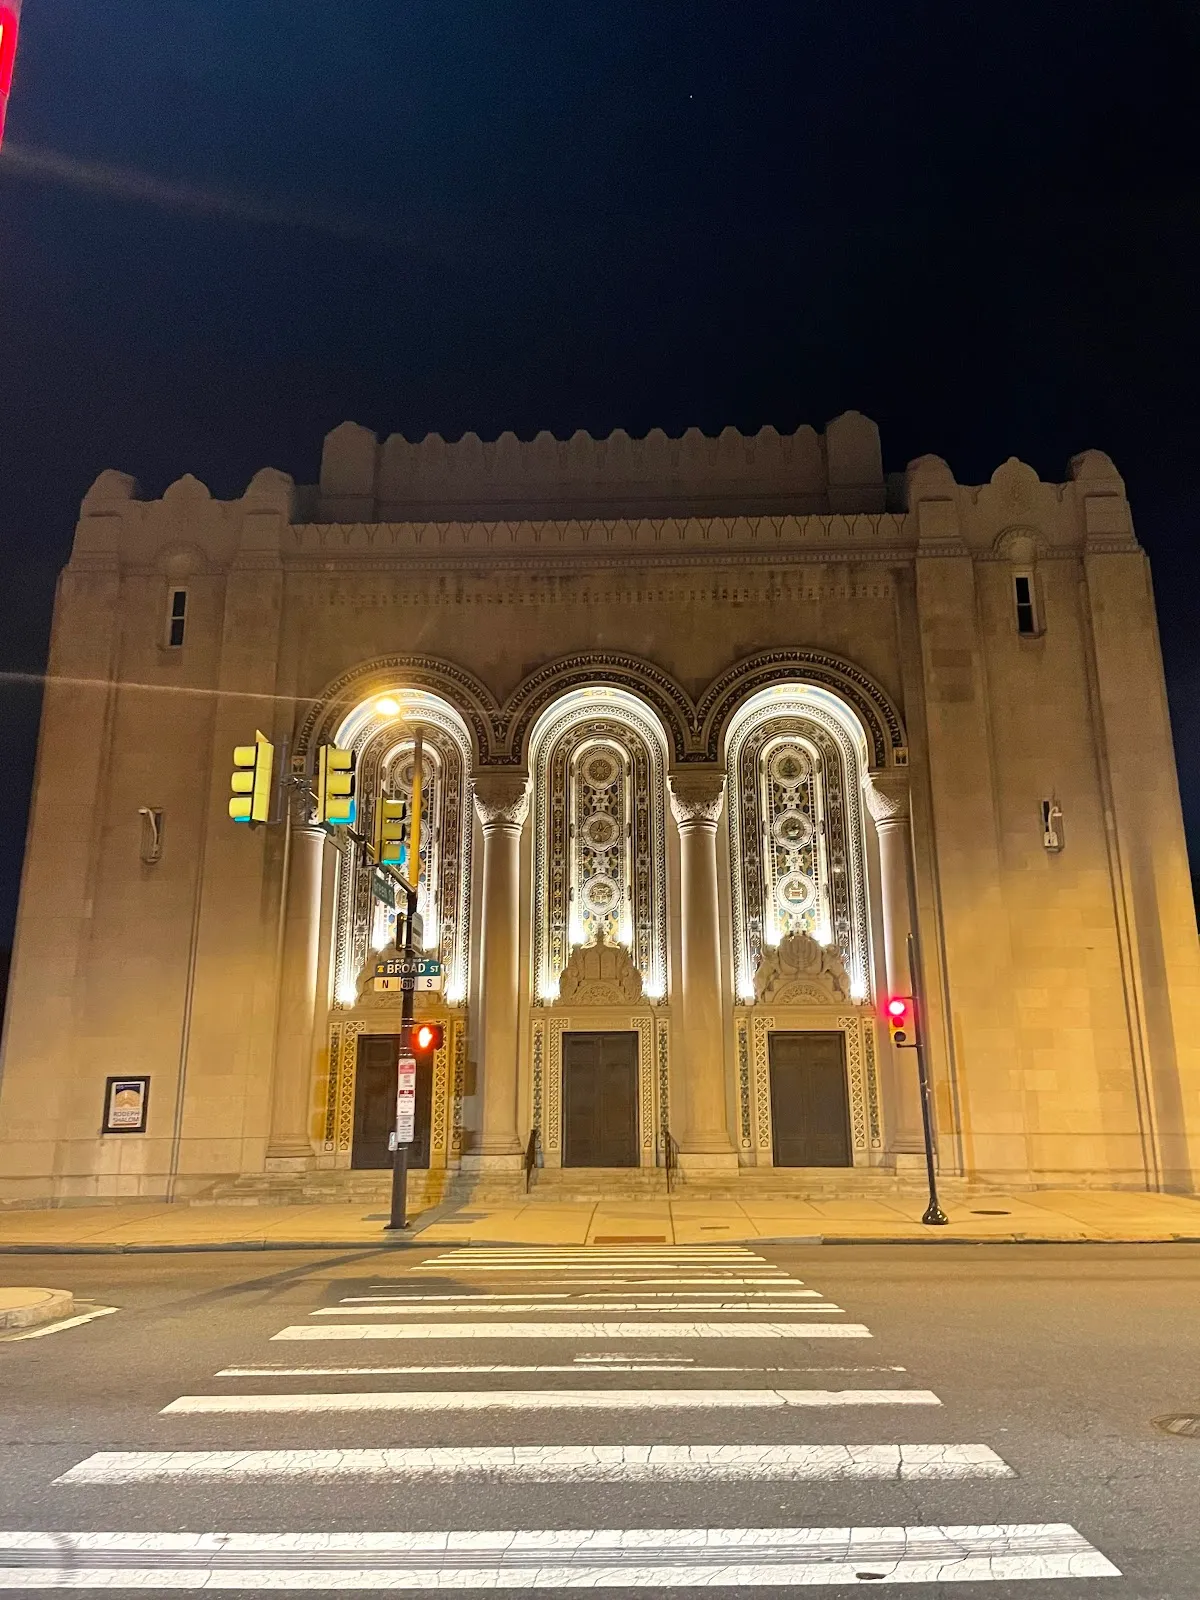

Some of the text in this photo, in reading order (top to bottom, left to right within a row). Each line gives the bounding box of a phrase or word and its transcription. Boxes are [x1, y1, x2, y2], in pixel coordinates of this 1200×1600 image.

[386, 963, 439, 974] BROAD ST
[382, 980, 389, 988] N
[426, 979, 433, 988] S
